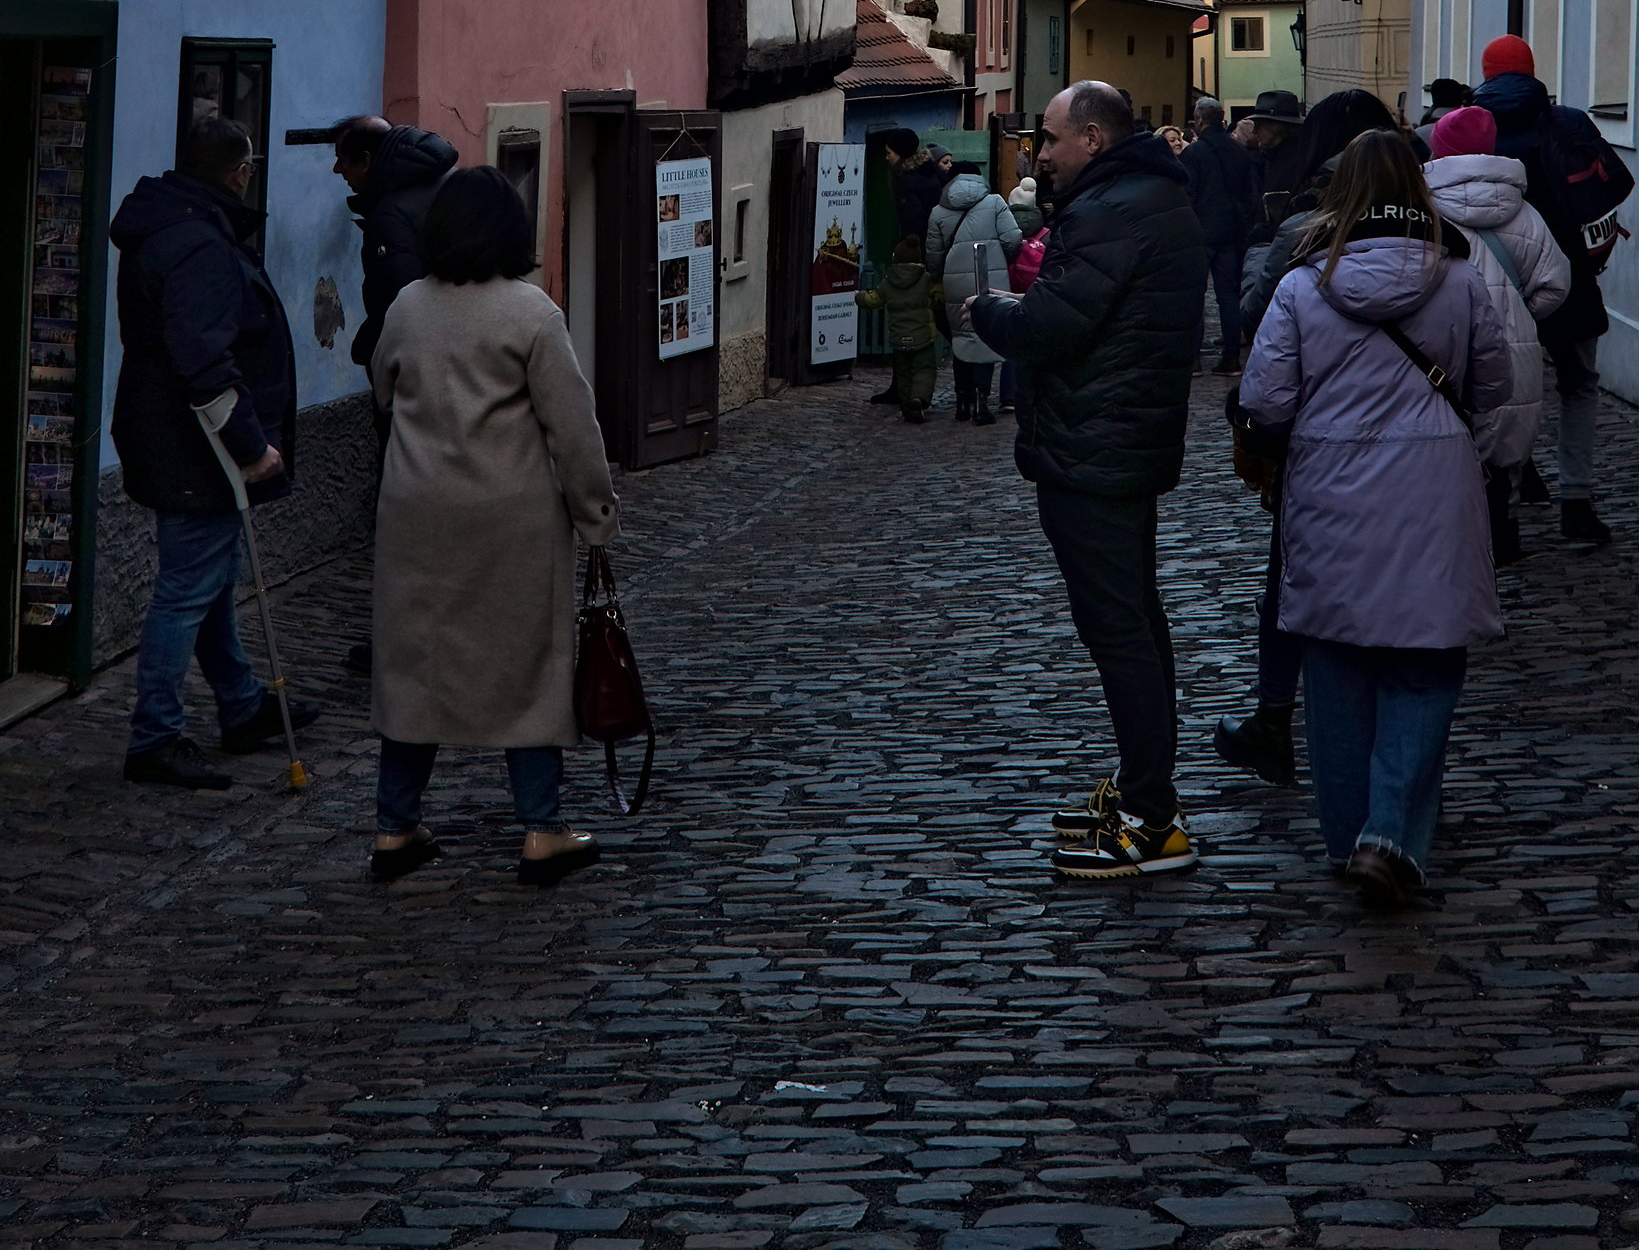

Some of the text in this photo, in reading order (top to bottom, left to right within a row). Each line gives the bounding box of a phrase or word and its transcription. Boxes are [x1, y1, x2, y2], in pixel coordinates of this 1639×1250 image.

[661, 167, 709, 182] LITTLE HOUSES
[843, 189, 858, 197] CZECH
